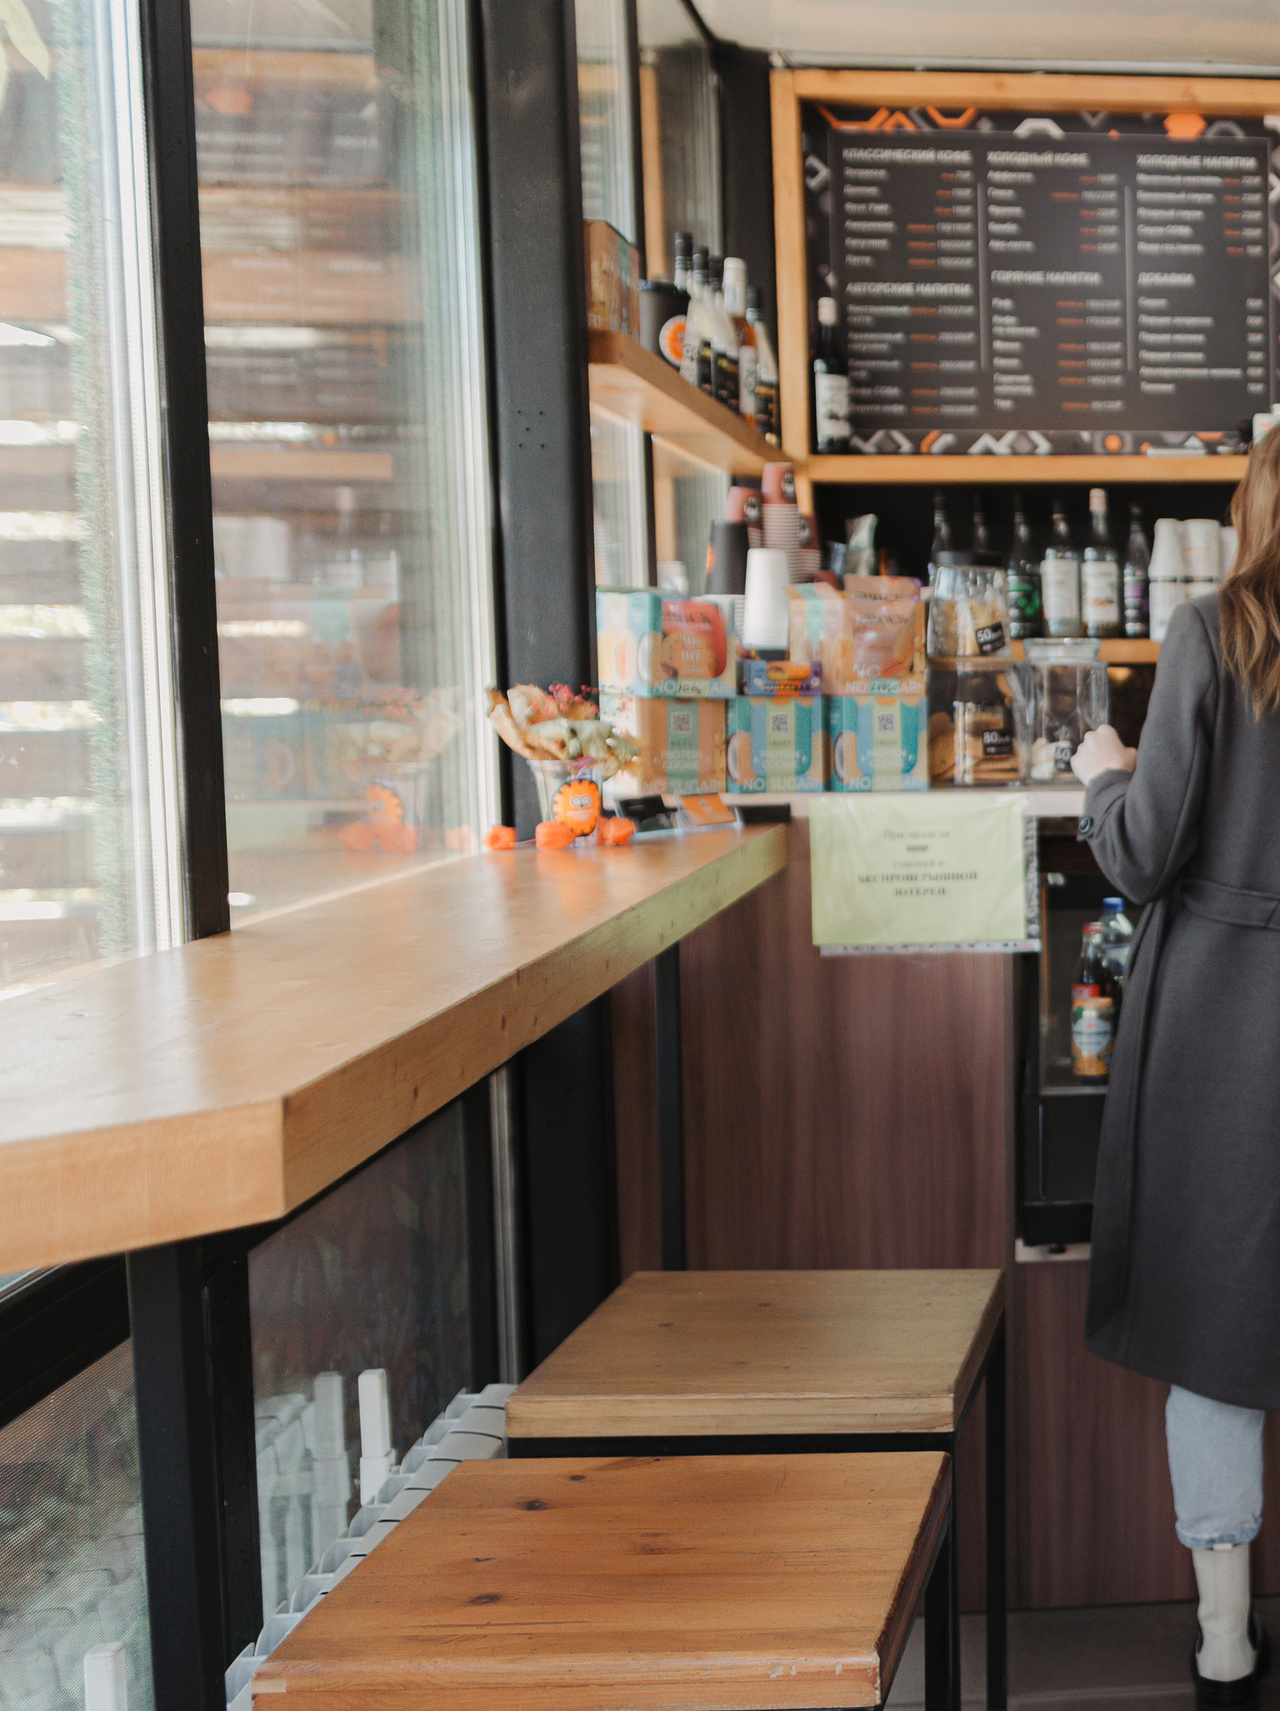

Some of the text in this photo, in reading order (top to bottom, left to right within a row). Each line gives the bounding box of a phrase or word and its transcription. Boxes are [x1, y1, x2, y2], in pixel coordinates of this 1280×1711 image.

[842, 148, 973, 165] КЛАССИЧЕСКИЙ КОФЕ
[987, 150, 1091, 168] ХОЛОДНЫЙ КОФЕ
[1136, 154, 1258, 171] ХОЛОДНЫЕ НАПИТКИ
[991, 270, 1102, 287] ГОРЯЧИЕ НАПИТКИ
[1137, 272, 1197, 288] ДОБАВКИ
[846, 282, 974, 297] АВТОРСКИЕ НАПИТКИ
[743, 777, 765, 791] NO
[849, 775, 871, 790] NO
[858, 870, 978, 883] БЕСПРОИГРЫШНОЙ
